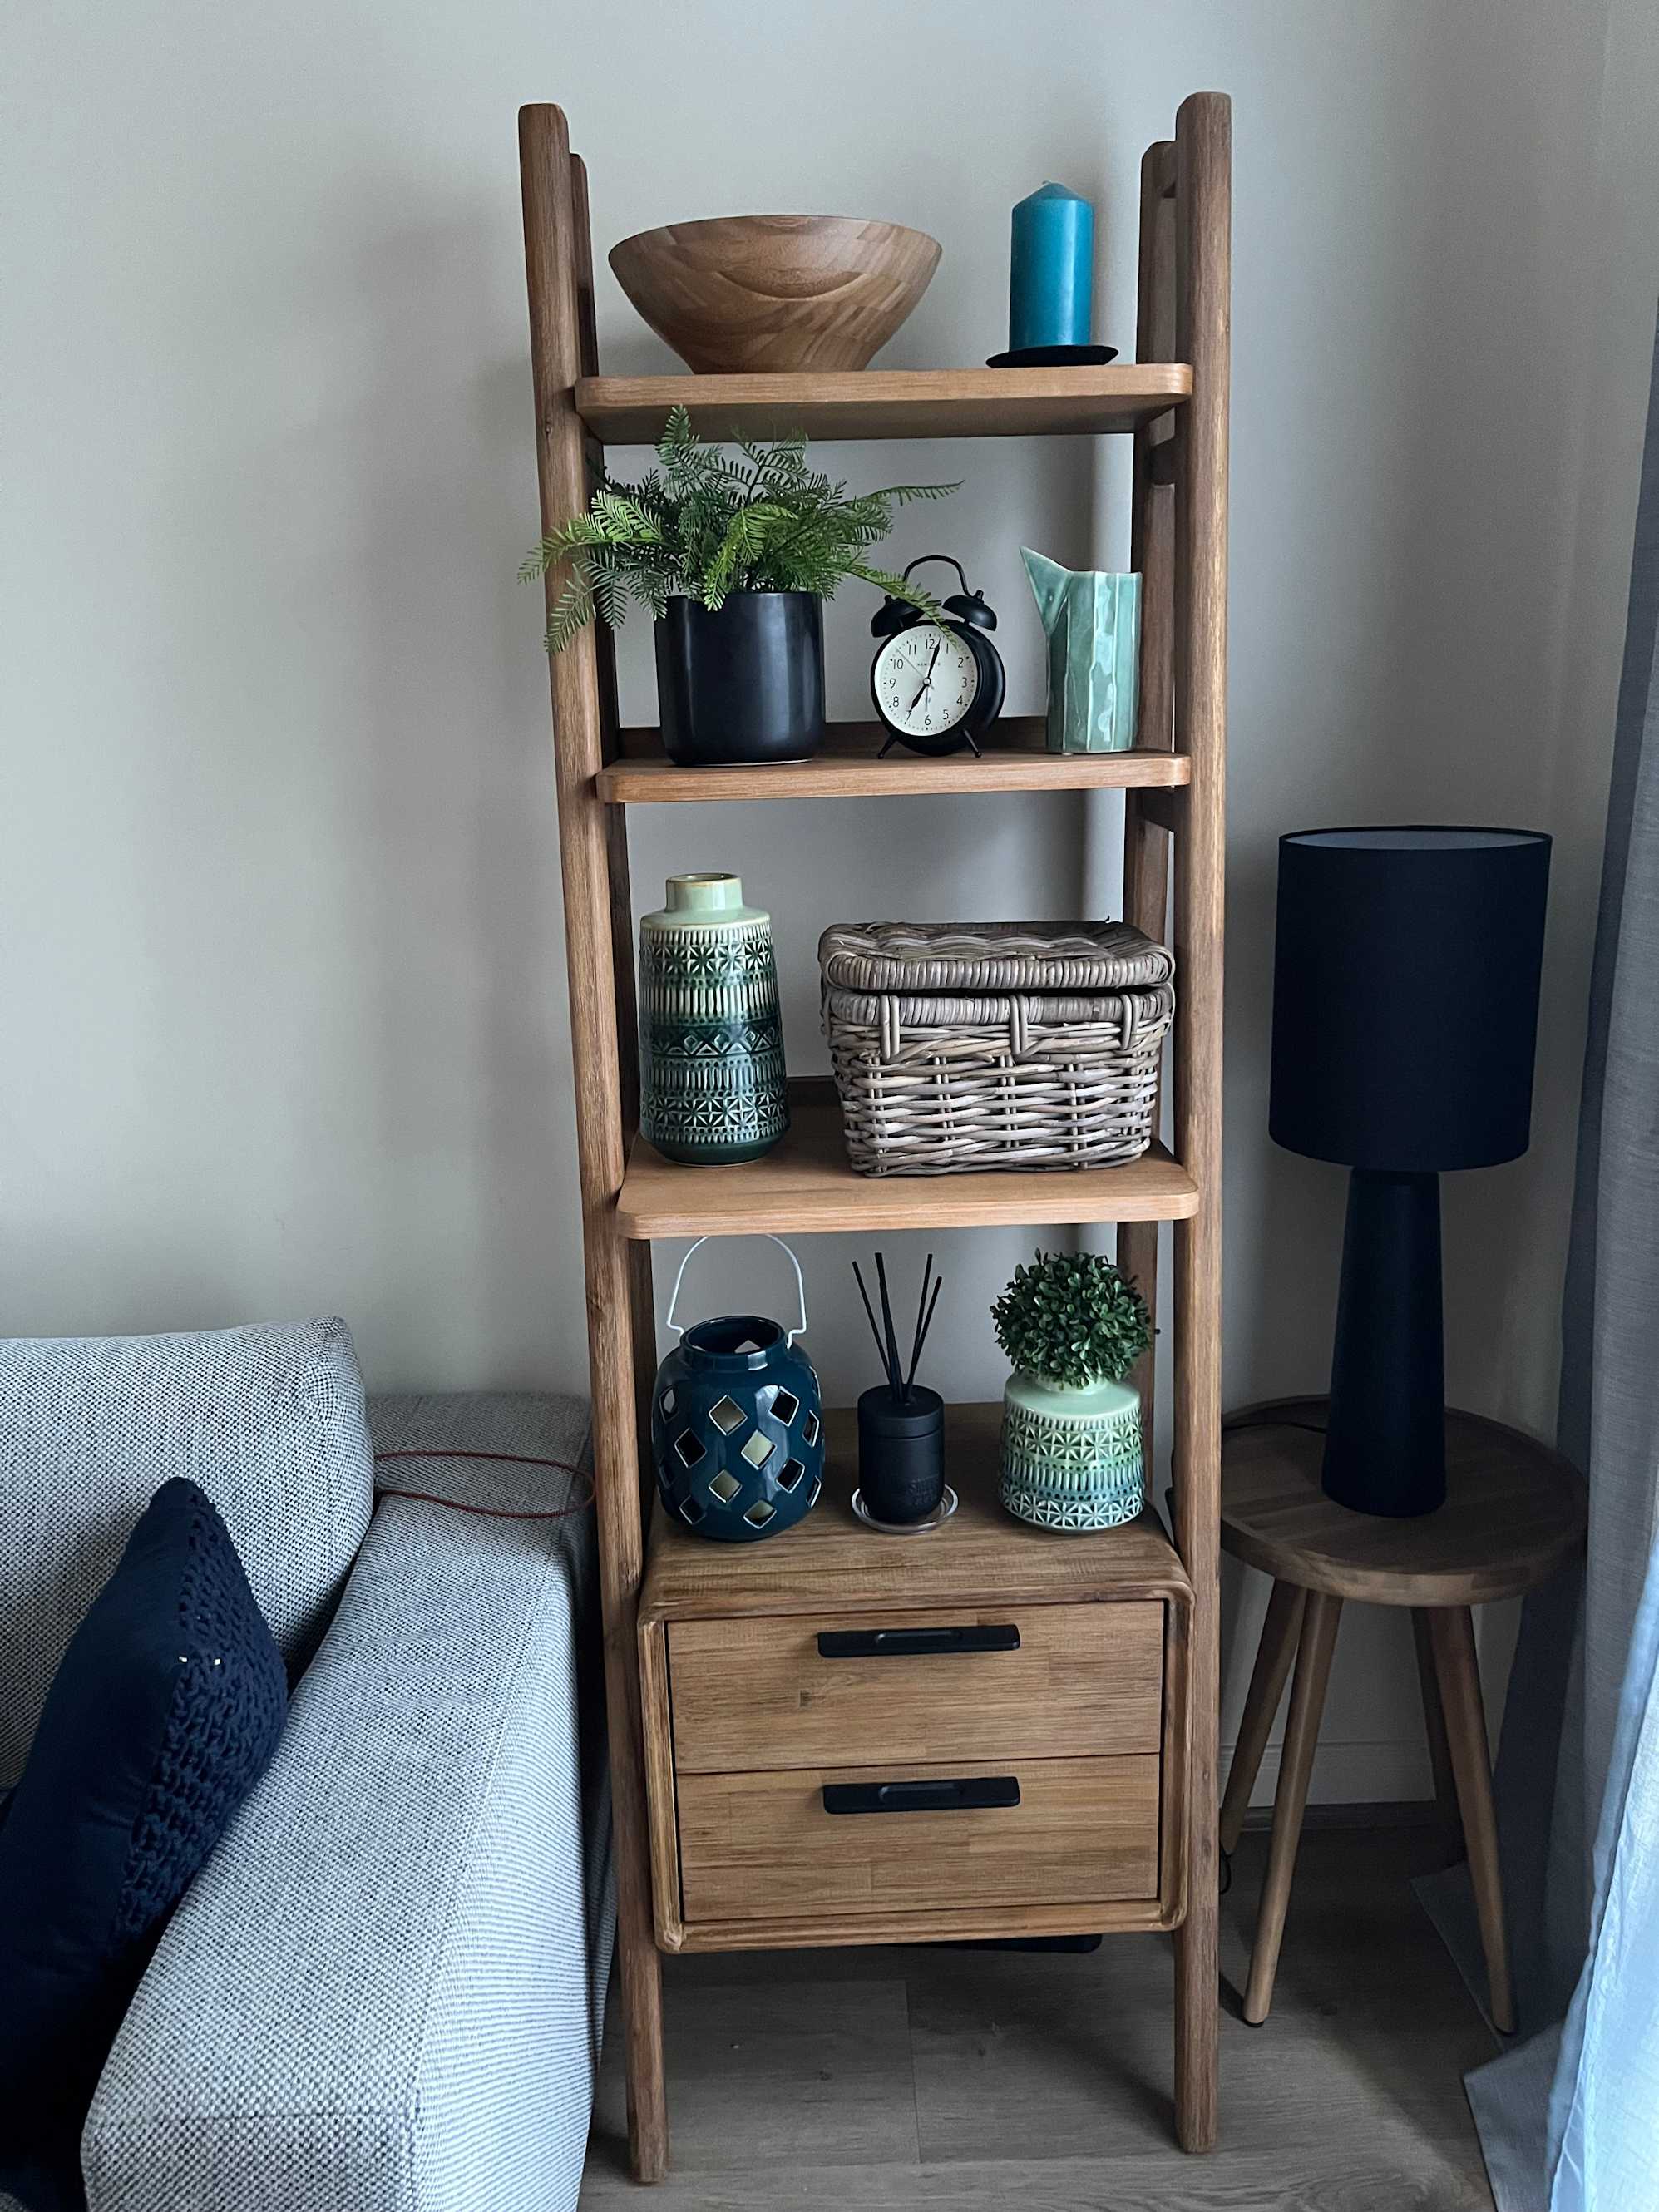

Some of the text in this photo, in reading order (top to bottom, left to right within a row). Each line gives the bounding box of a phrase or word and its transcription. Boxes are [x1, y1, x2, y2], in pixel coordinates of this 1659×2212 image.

[908, 644, 916, 655] 11
[926, 639, 935, 649] 12
[946, 643, 949, 654] 1
[893, 659, 904, 669] 10
[957, 657, 964, 668] 2
[889, 678, 896, 689] 9
[961, 677, 967, 688] 3
[892, 696, 899, 707] 8
[956, 695, 963, 705] 4
[924, 714, 931, 725] 6
[942, 709, 949, 719] 5
